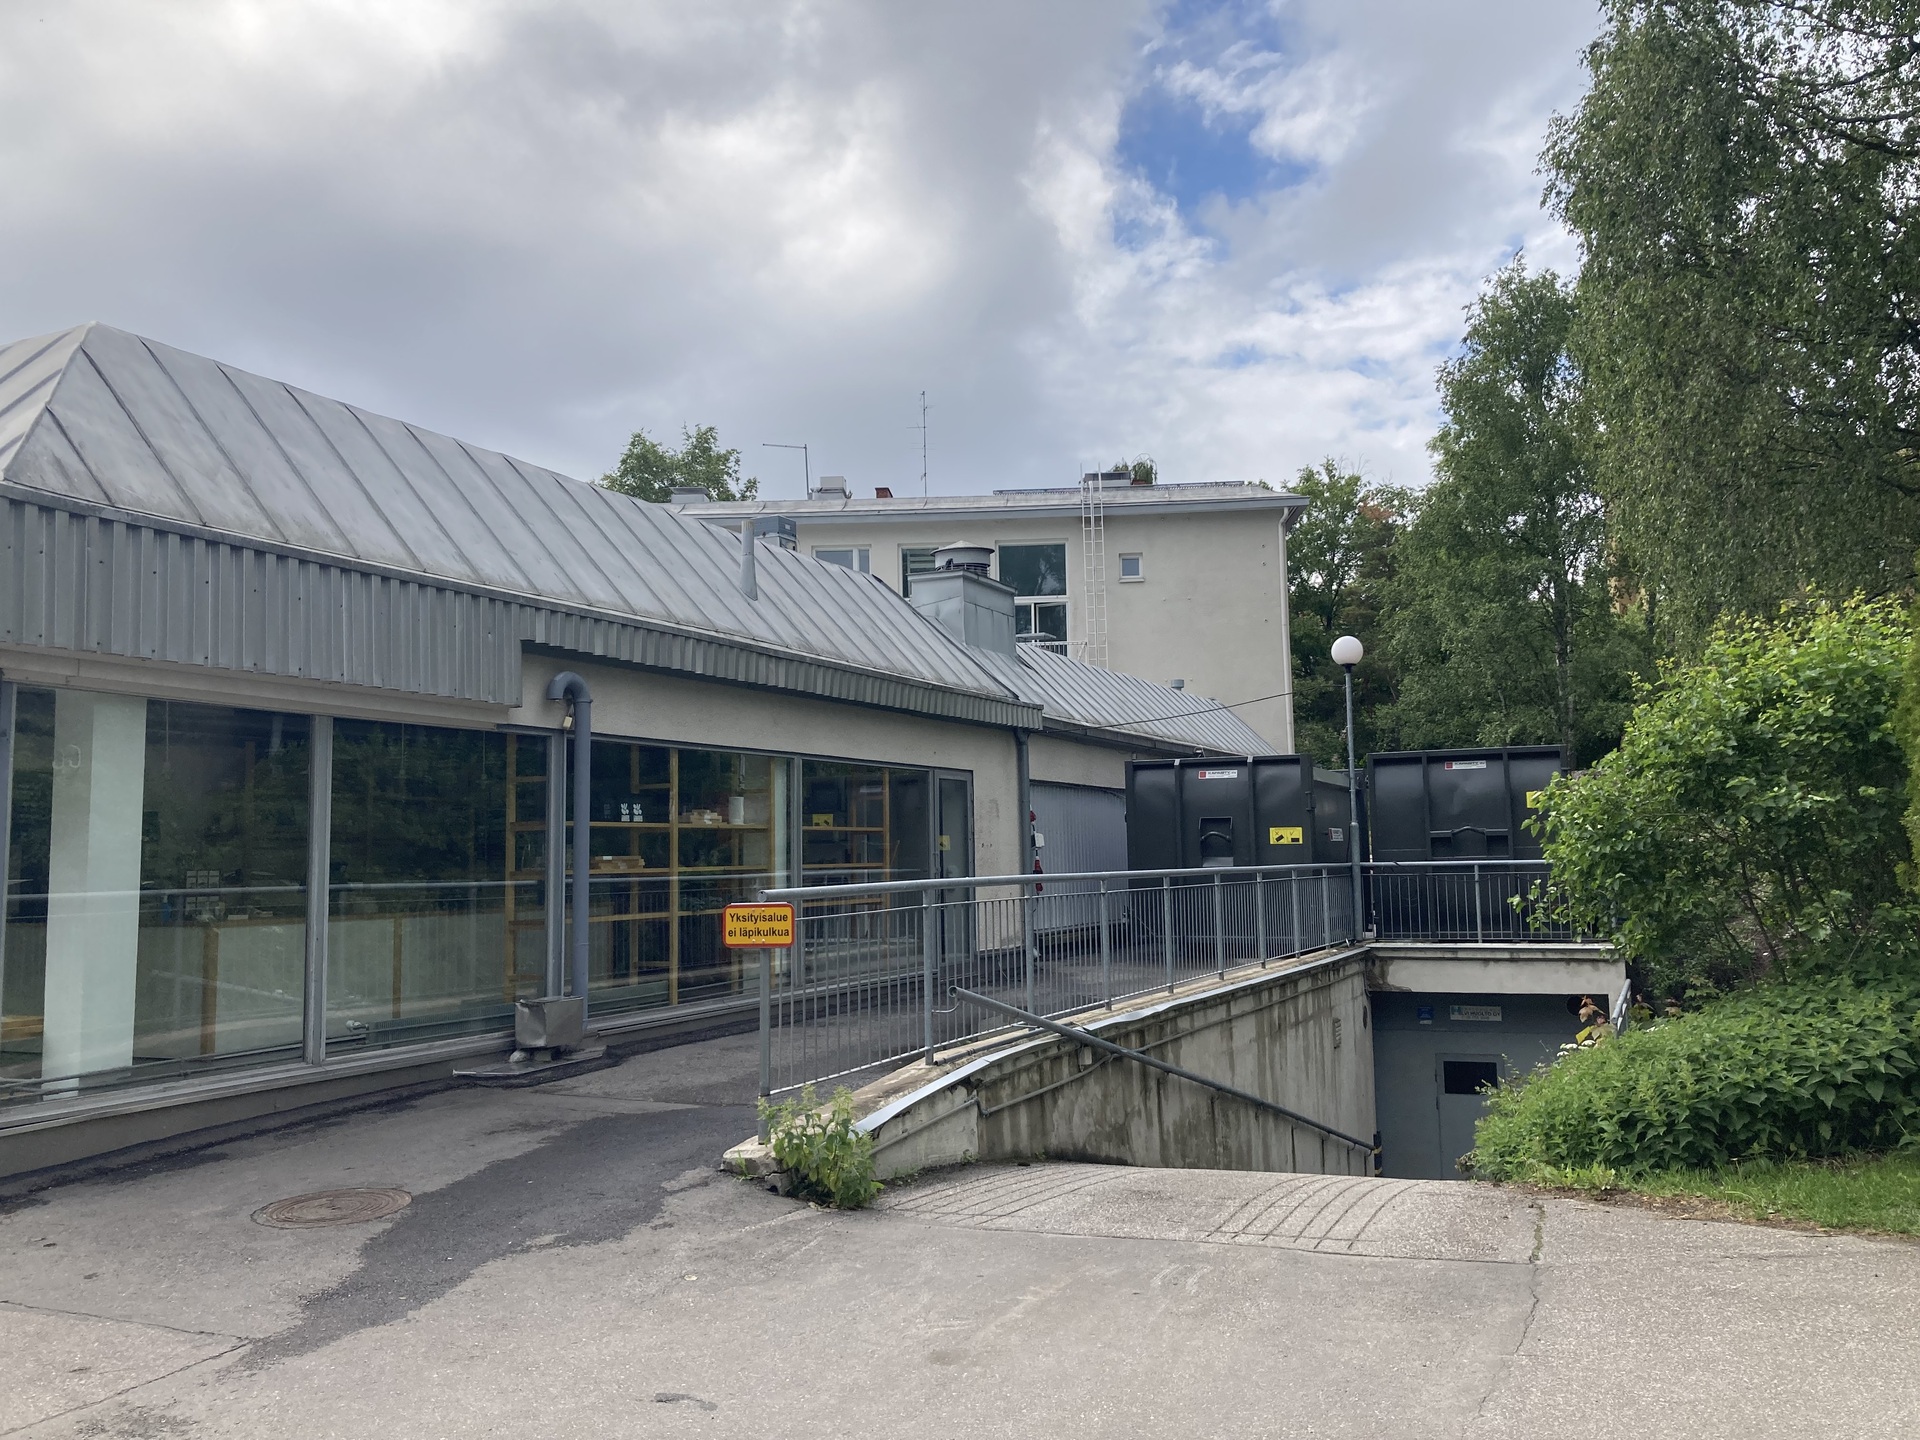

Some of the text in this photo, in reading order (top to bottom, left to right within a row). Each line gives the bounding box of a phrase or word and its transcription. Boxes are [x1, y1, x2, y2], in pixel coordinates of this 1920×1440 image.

[729, 912, 788, 924] Yksityisalue
[728, 927, 789, 939] ei läpikulkua
